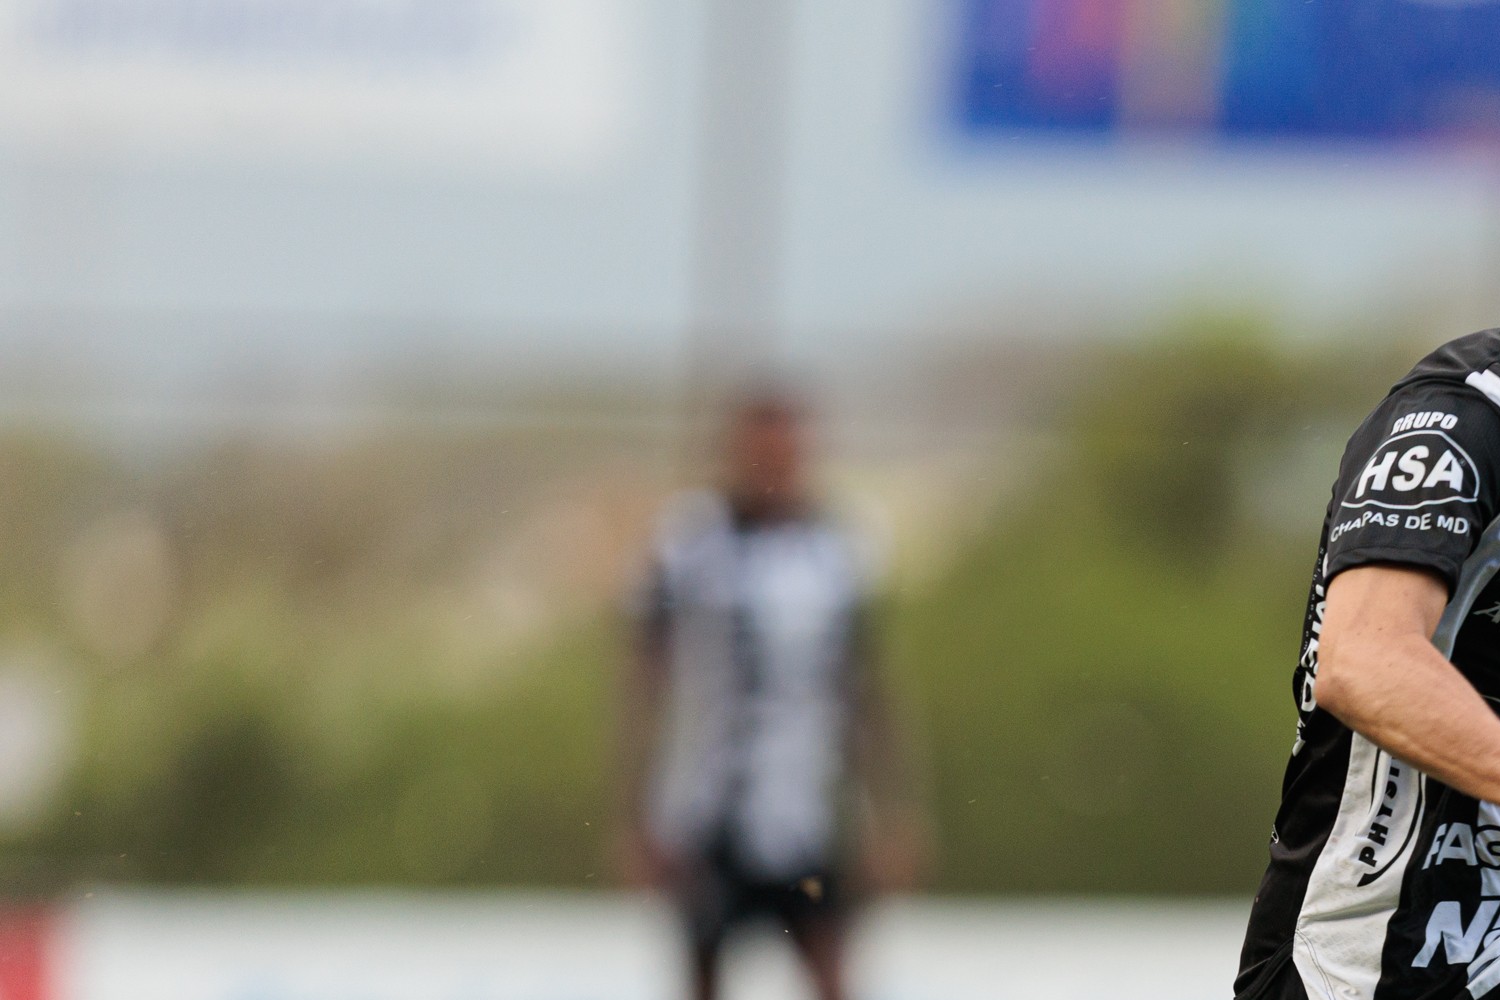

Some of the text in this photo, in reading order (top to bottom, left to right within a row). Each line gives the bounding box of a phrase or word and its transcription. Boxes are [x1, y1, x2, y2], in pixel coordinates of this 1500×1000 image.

[1390, 411, 1458, 436] GRUPO
[1355, 445, 1464, 499] HSA
[1330, 511, 1470, 542] CHAPAS DE MD
